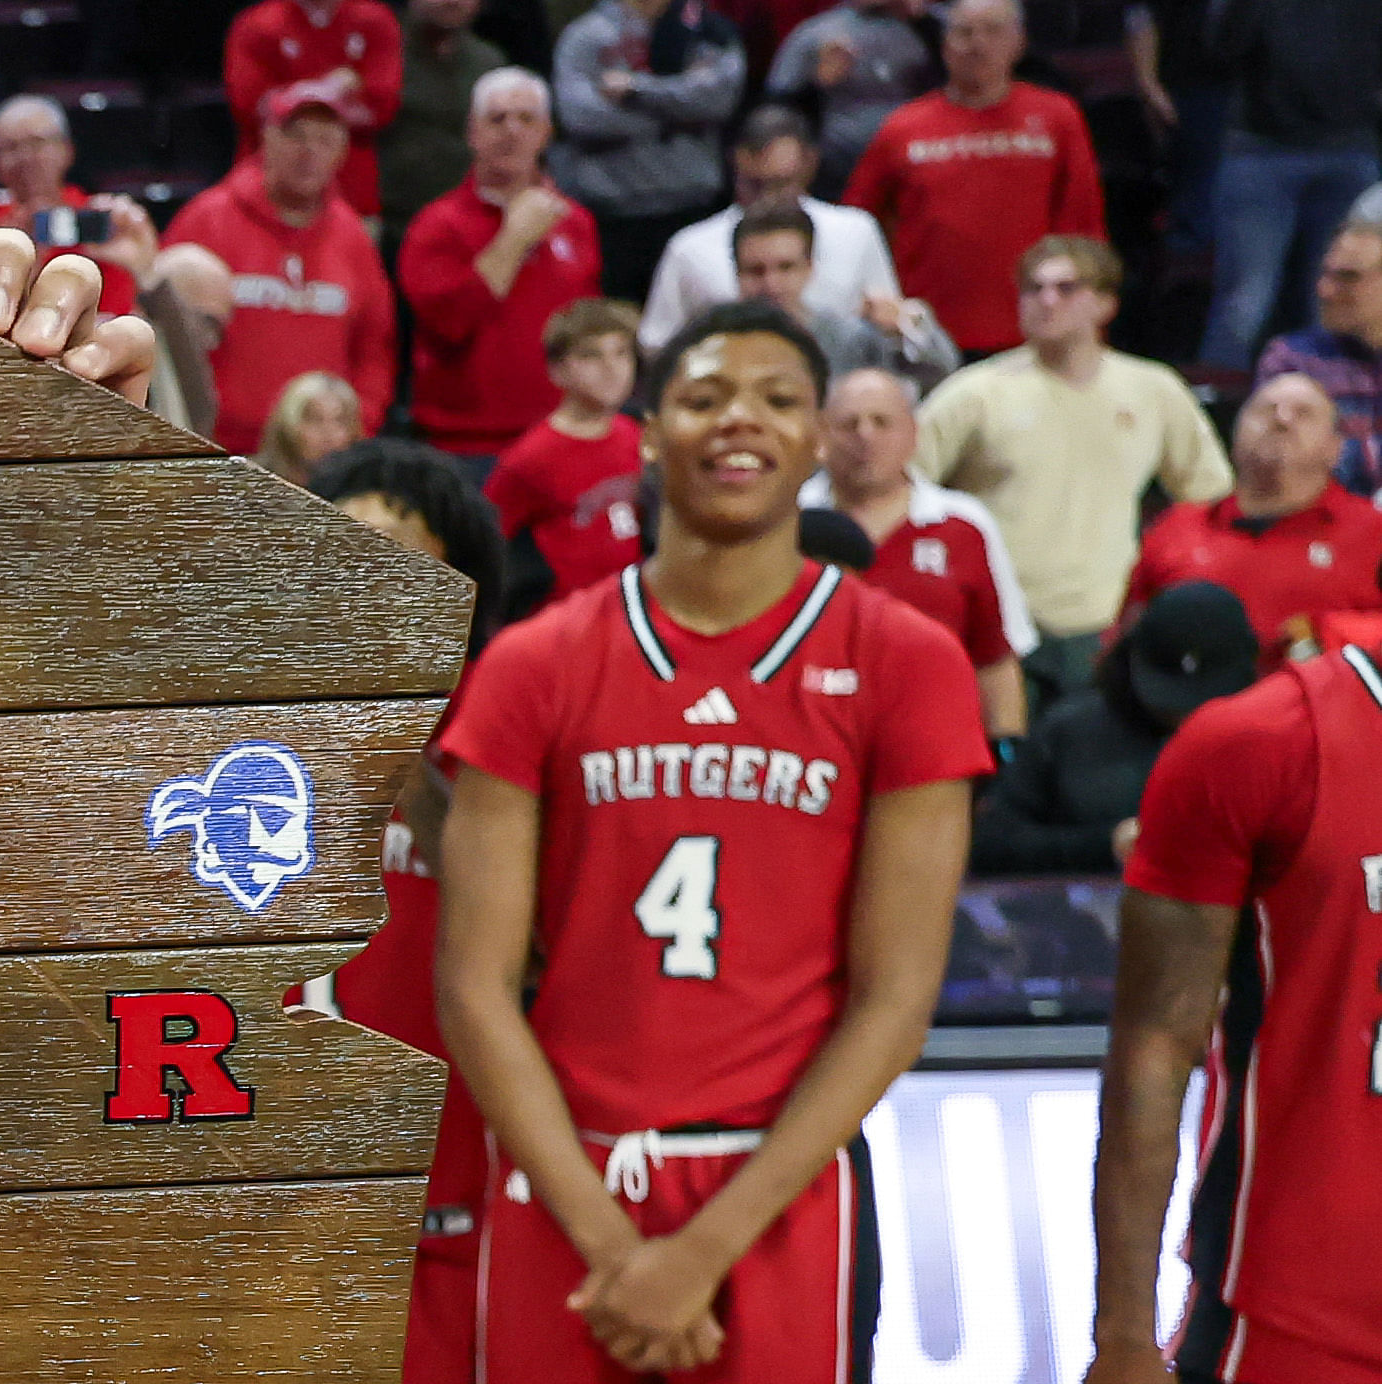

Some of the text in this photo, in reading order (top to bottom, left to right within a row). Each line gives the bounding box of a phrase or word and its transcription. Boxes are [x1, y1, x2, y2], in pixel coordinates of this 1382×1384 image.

[579, 742, 839, 816] RUTGERS
[633, 834, 721, 981] 4
[103, 987, 255, 1125] R
